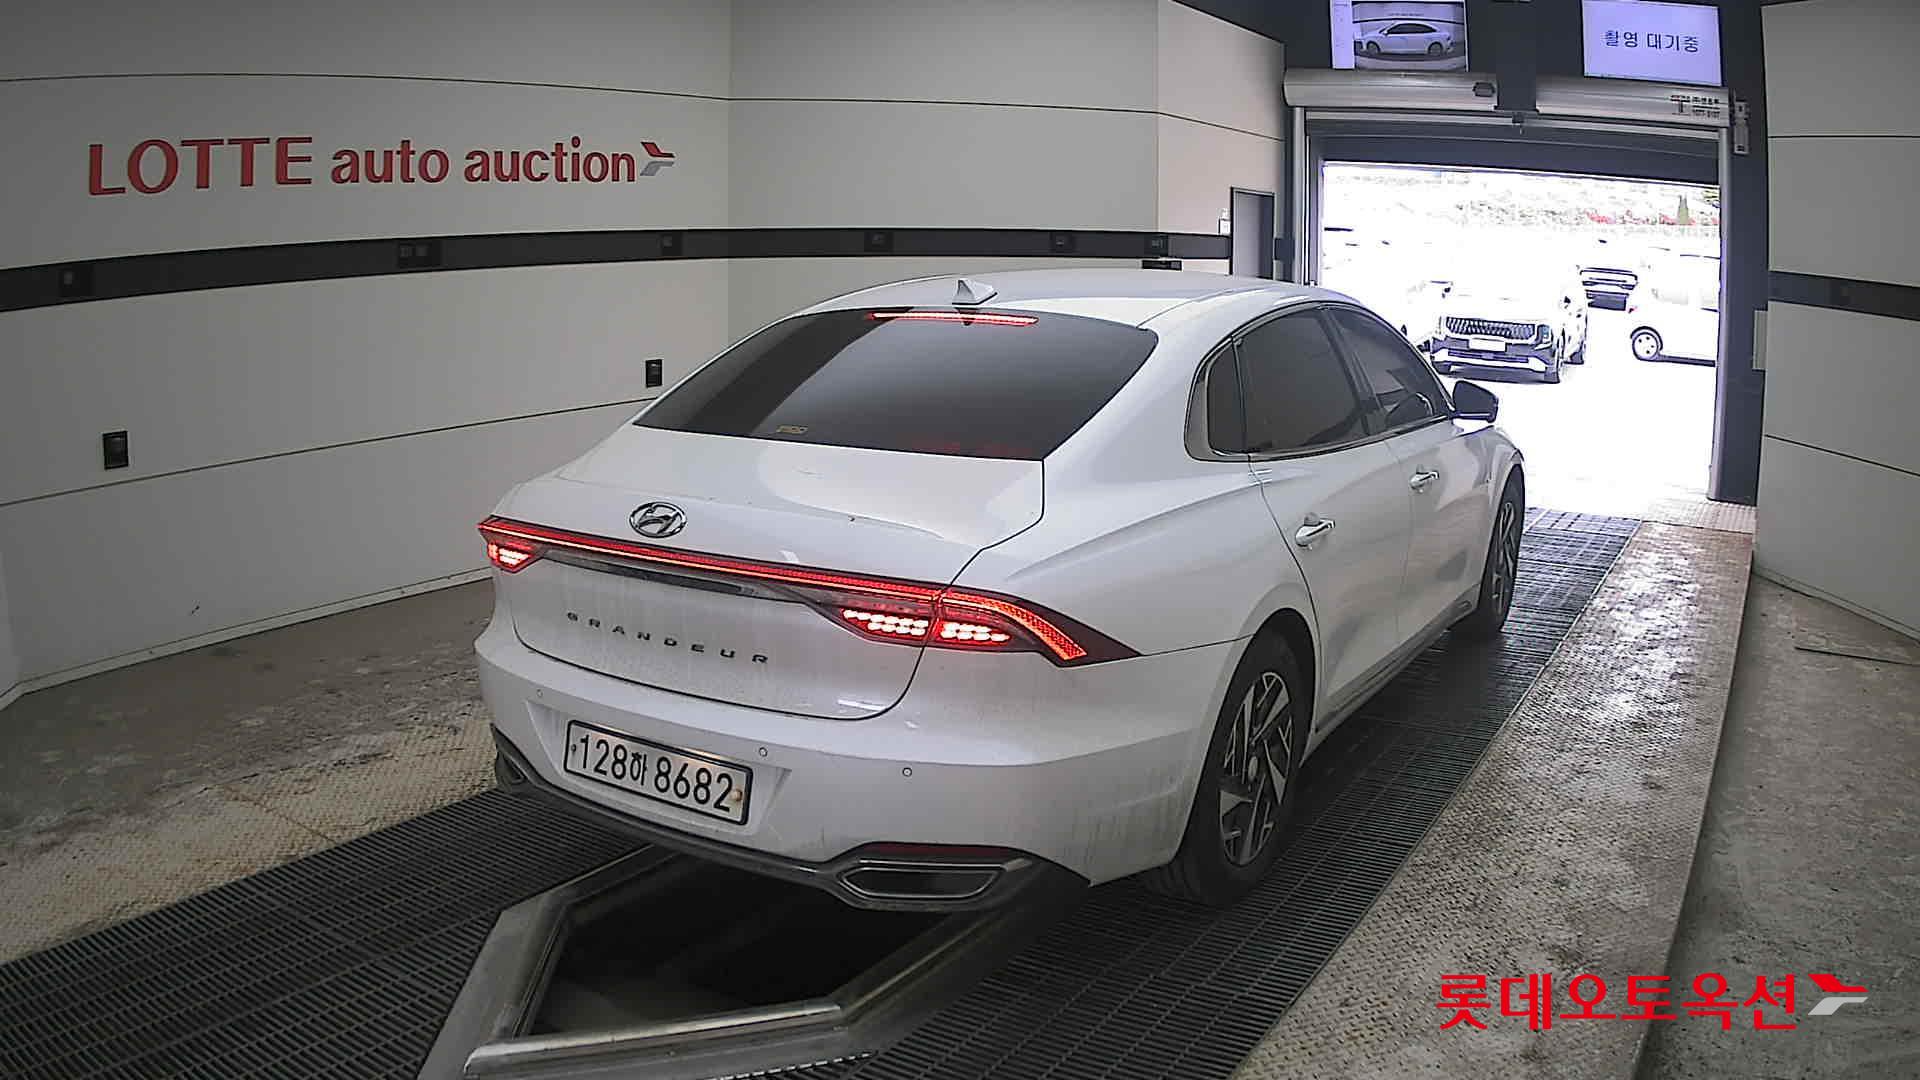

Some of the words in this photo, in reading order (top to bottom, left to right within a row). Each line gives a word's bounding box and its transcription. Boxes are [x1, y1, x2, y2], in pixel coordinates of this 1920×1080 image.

[1646, 33, 1699, 53] 대기중
[88, 136, 313, 196] LOTTE
[330, 139, 450, 184] auto
[463, 136, 636, 183] auction
[566, 611, 769, 664] GRANDEUR
[580, 734, 647, 786] 128하
[654, 756, 733, 812] 8682
